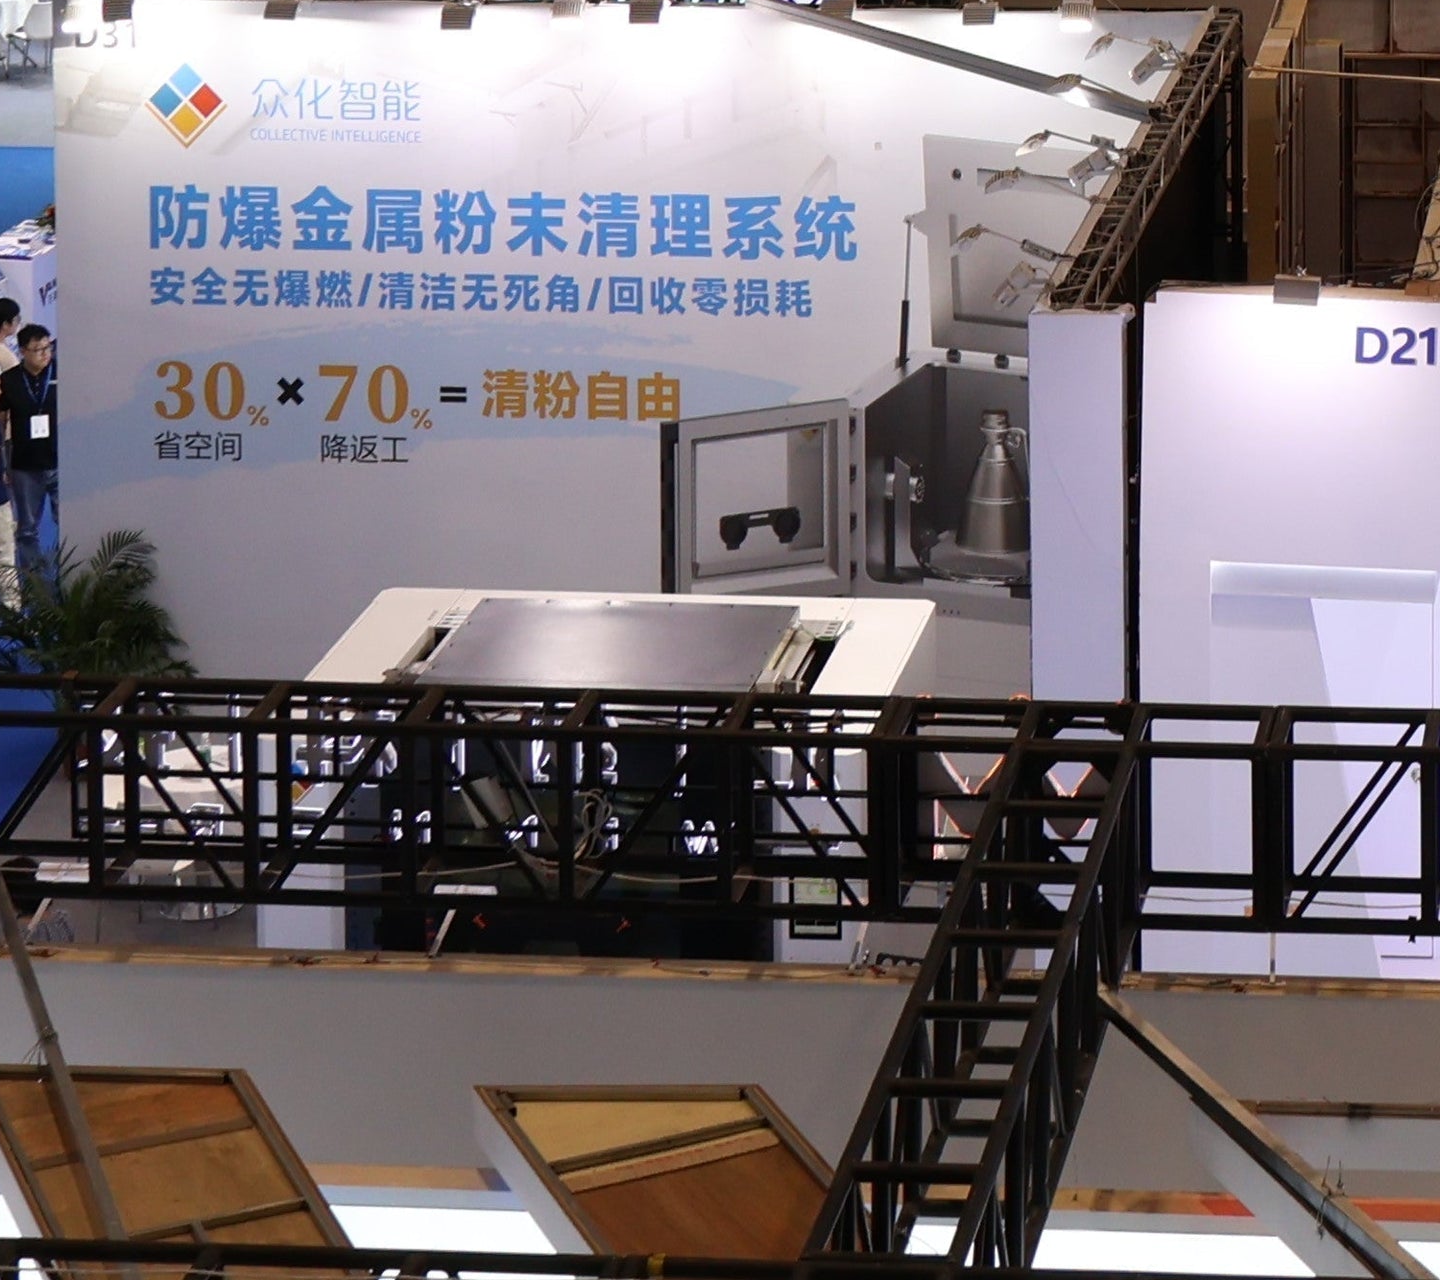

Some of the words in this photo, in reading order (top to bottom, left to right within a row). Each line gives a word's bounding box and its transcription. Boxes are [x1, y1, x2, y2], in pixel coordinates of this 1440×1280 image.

[250, 77, 423, 124] 众化智能
[250, 128, 328, 145] COLLECTIVE
[329, 128, 423, 146] INTELLIGENCE
[148, 185, 859, 263] 防爆金属粉末清理系统
[148, 269, 815, 320] 安全无爆燃/清洁无死角/回收零损耗
[1355, 325, 1439, 367] D21
[153, 359, 269, 428] 30%
[317, 363, 433, 429] 70%
[481, 368, 682, 422] 清粉自由
[153, 430, 243, 462] 省空间
[319, 435, 409, 464] 降返工
